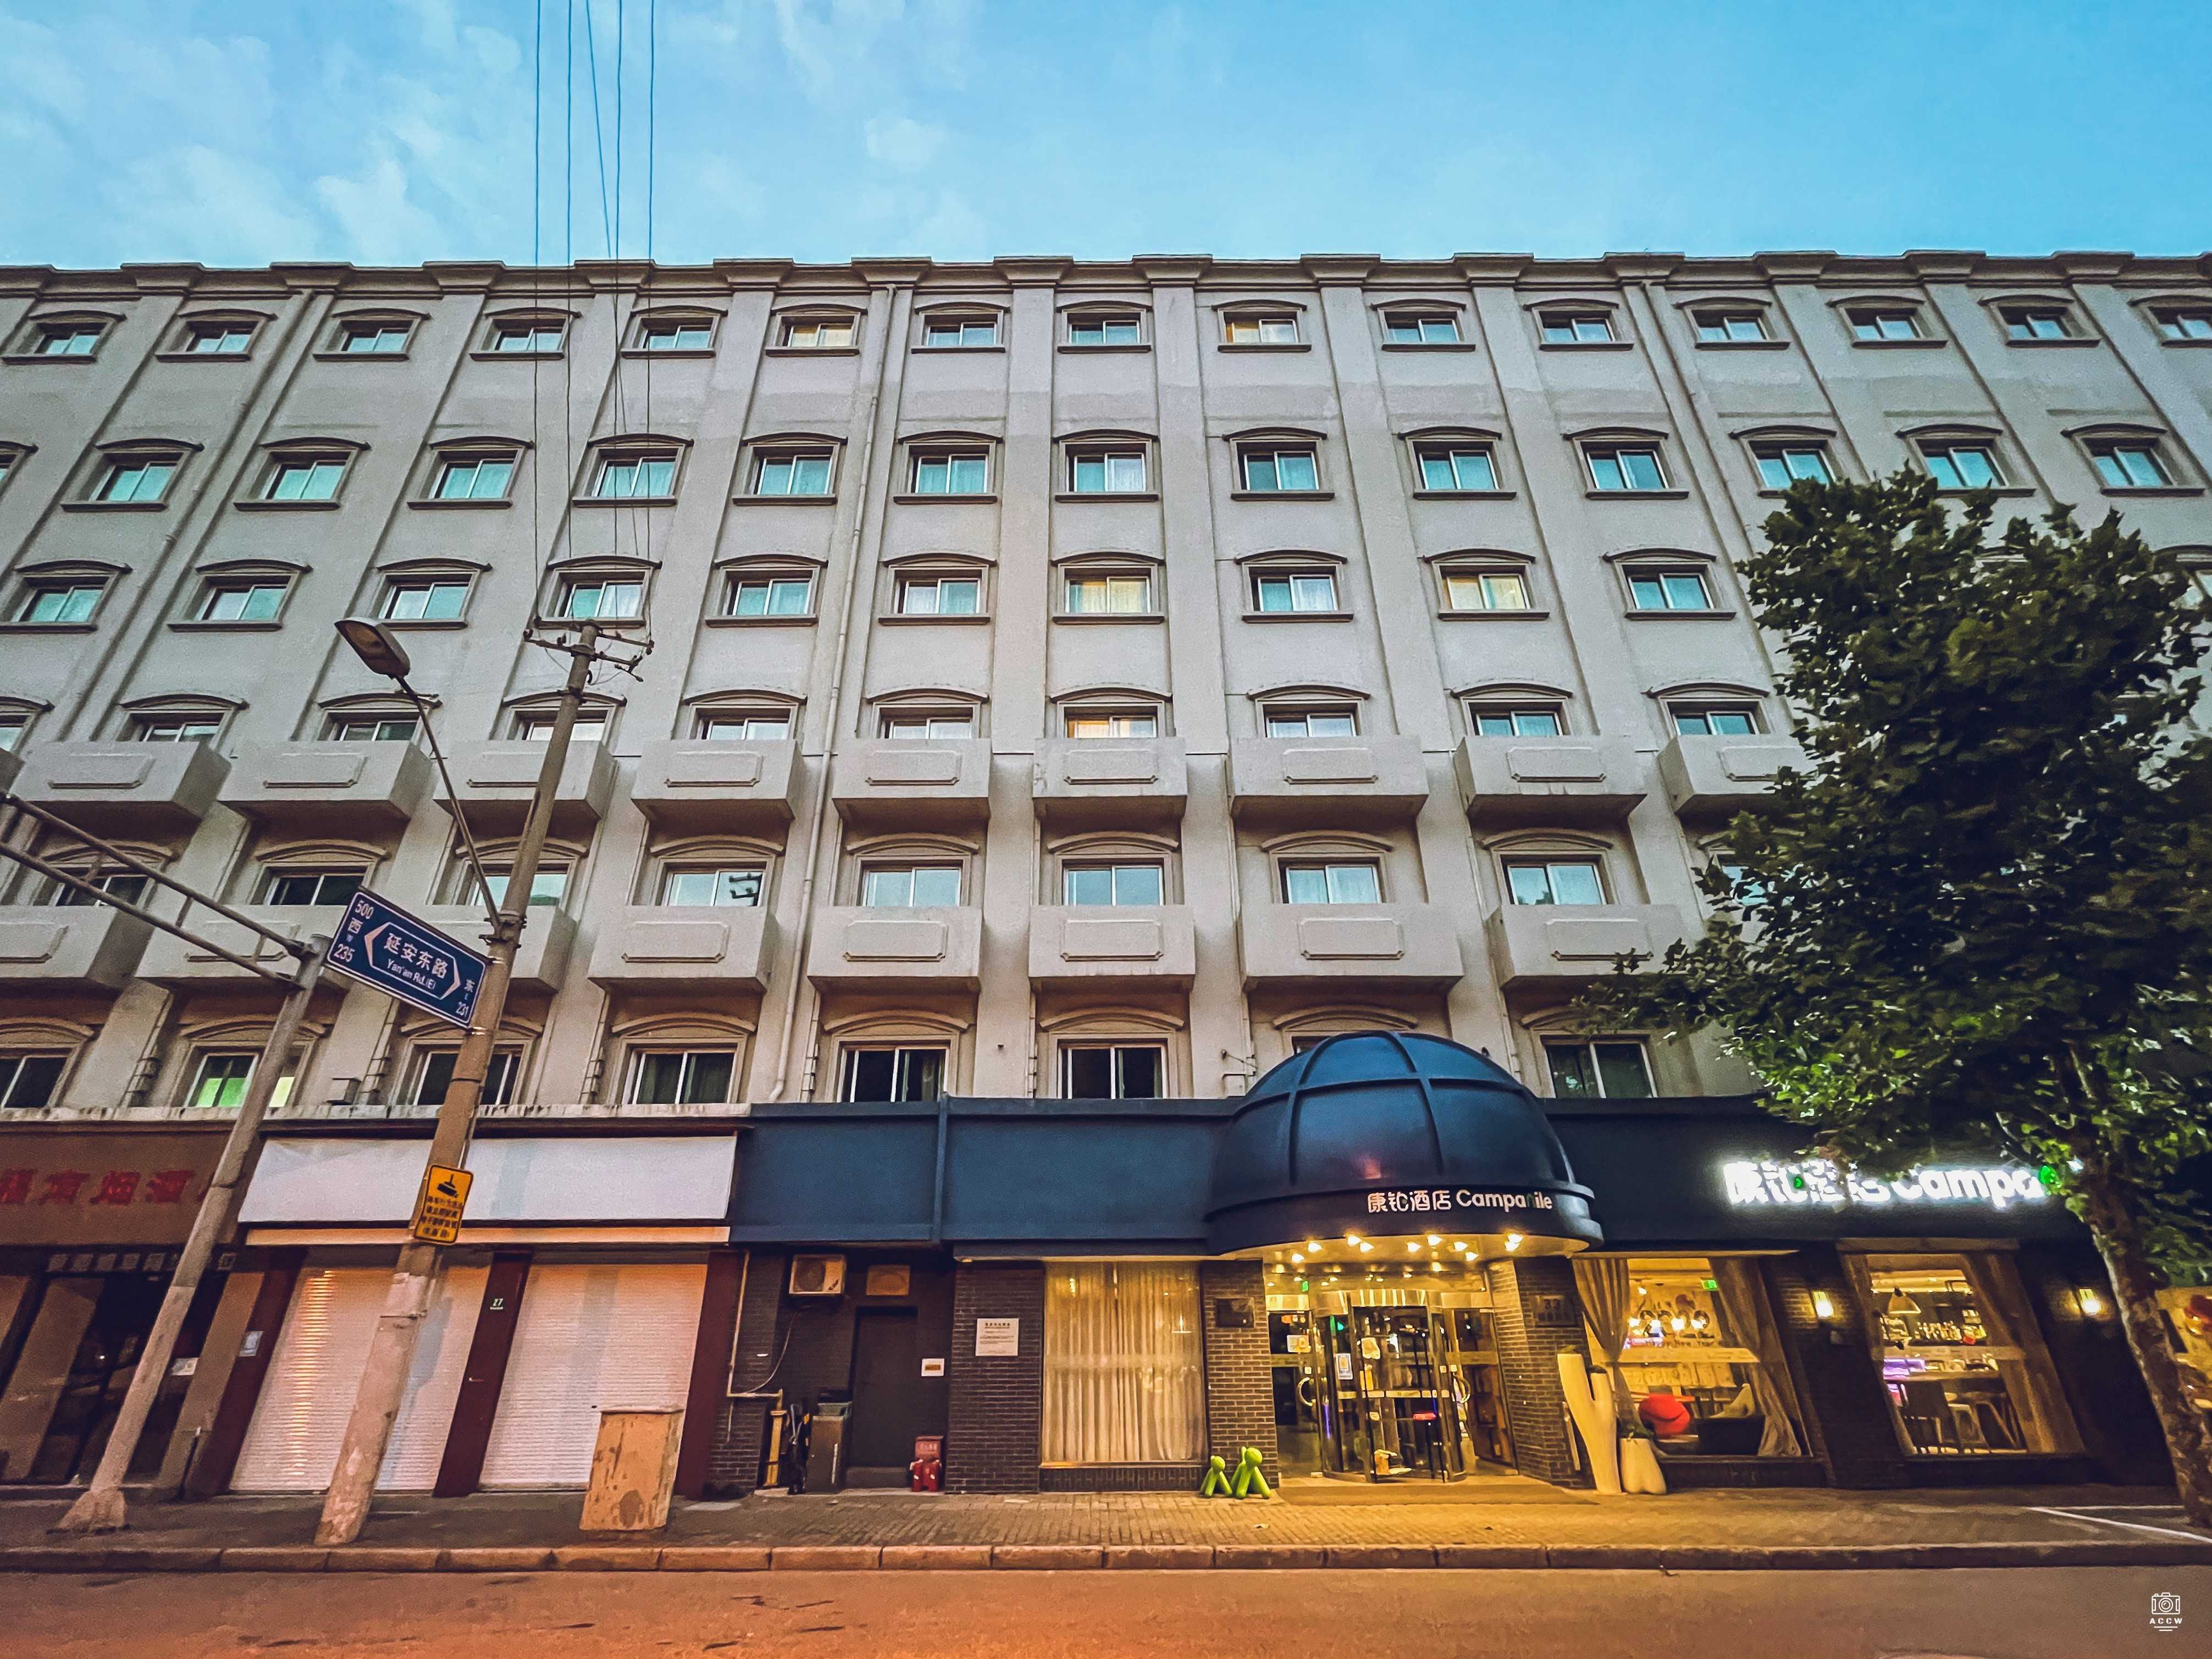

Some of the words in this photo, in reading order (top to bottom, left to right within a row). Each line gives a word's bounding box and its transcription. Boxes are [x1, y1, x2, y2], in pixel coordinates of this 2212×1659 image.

[355, 900, 374, 920] 500
[347, 917, 363, 934] 西
[333, 943, 356, 963] 235
[384, 933, 449, 979] 延安东路
[464, 978, 475, 993] 东
[456, 1002, 469, 1017] 231
[1890, 1157, 2045, 1208] Campa
[1367, 1189, 1452, 1214] 康铂酒店
[1456, 1189, 1552, 1213] Campanile
[493, 1298, 504, 1307] 27
